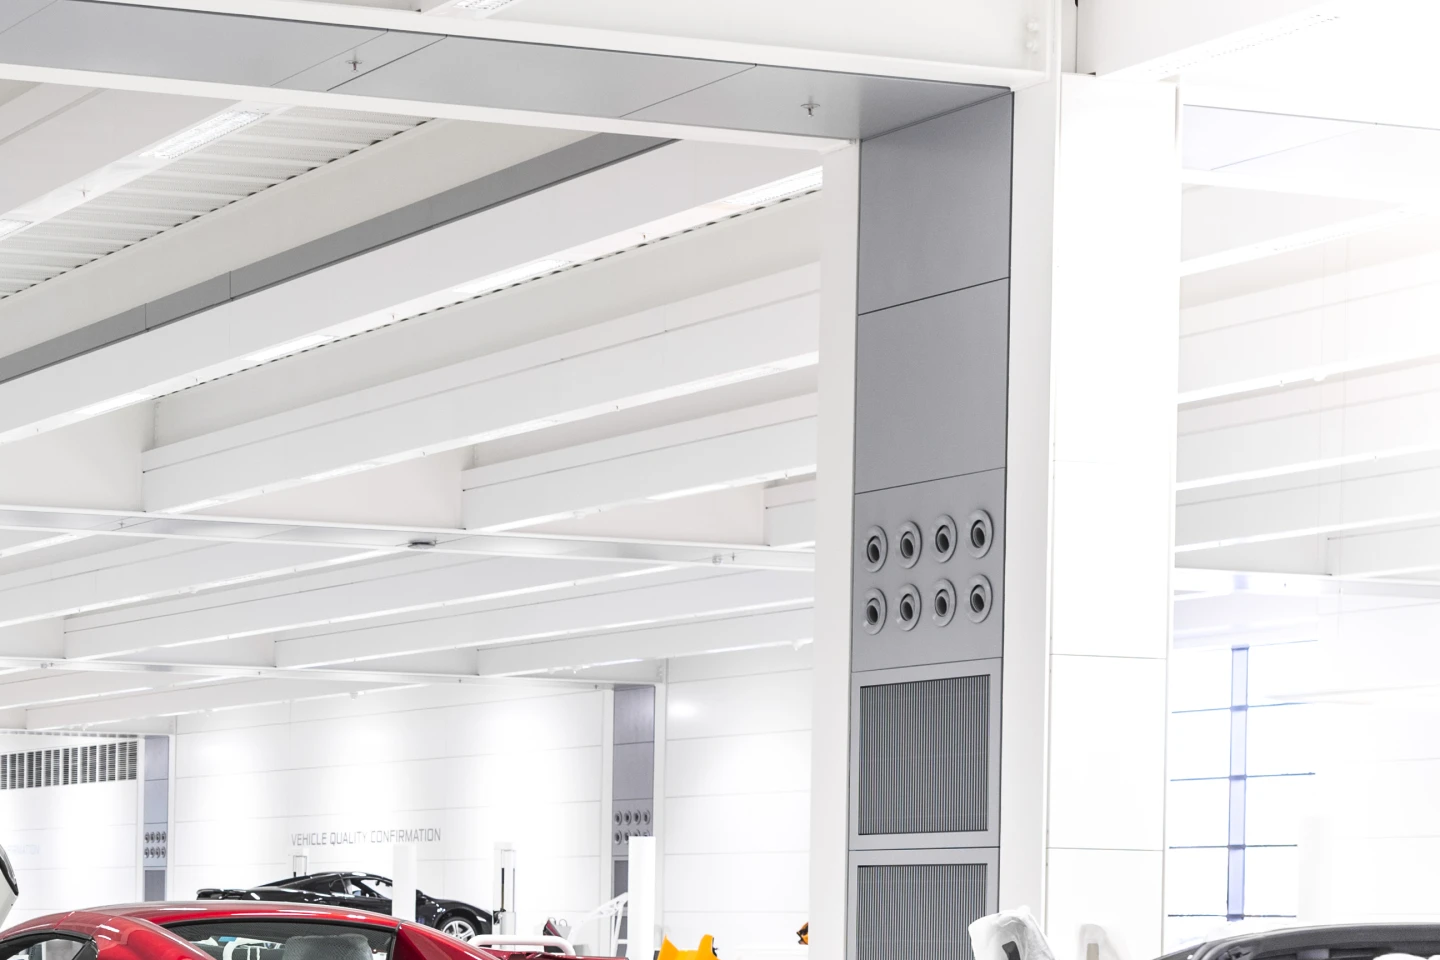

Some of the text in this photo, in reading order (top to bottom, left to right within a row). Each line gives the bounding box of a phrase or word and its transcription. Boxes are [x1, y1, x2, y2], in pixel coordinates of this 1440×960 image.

[291, 828, 441, 846] VEHICLE QUALITY CONFIRMATION
